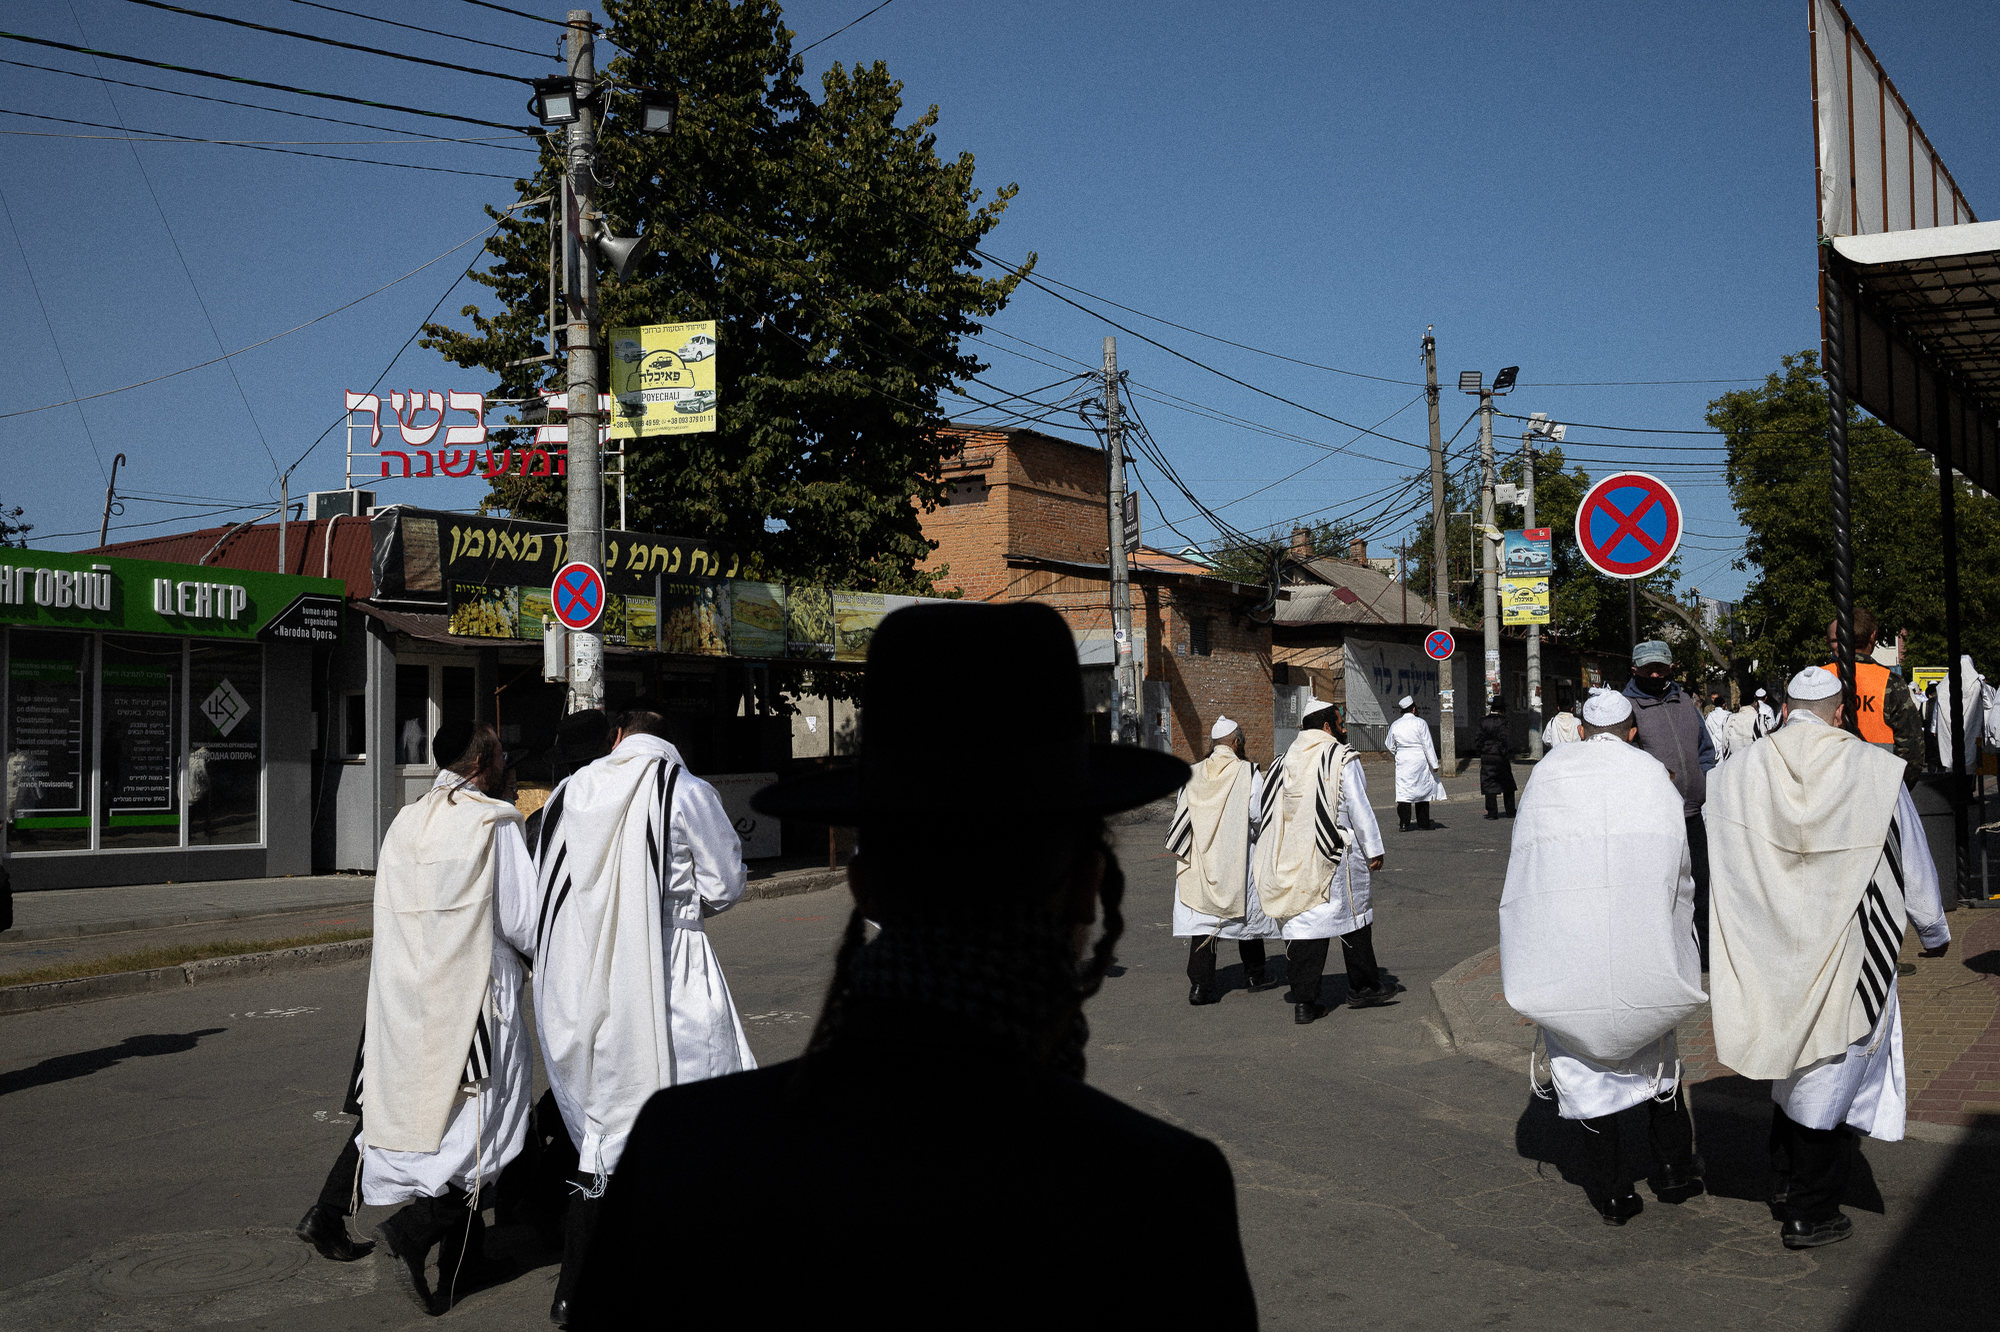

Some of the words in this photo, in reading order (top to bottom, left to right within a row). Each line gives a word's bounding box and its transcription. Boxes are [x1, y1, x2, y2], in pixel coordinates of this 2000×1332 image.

[641, 392, 680, 402] POYECHALI
[344, 388, 488, 448] בשר
[448, 524, 543, 566] מאומן
[689, 547, 720, 576] נח
[455, 583, 488, 595] פרגיות
[669, 583, 700, 595] פרגיות
[154, 578, 247, 620] ЦЕНТР
[302, 606, 320, 616] human
[321, 608, 338, 618] rights
[304, 618, 338, 627] organization
[16, 716, 54, 724] Construction
[38, 780, 74, 790] Provisioning
